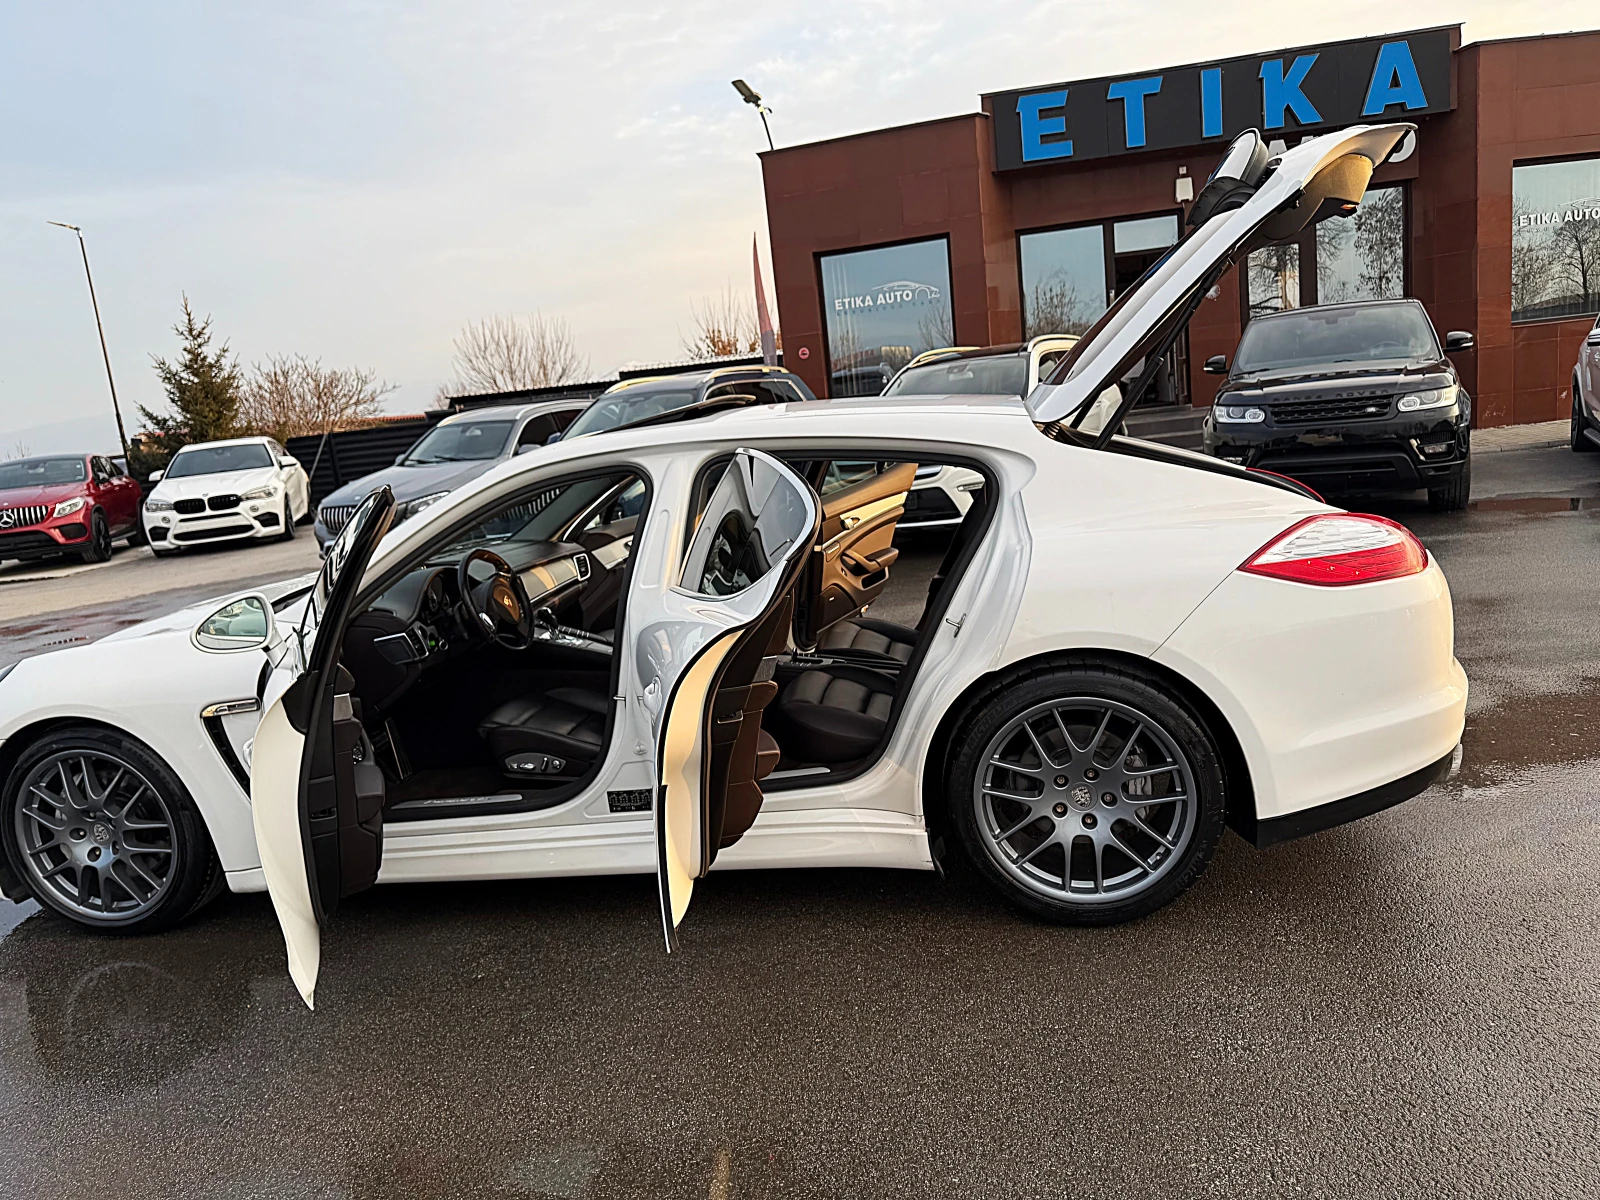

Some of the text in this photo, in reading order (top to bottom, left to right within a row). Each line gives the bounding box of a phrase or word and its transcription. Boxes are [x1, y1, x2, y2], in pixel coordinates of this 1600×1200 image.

[1016, 40, 1428, 162] ETIKA
[1518, 207, 1600, 227] ETIKA AUTO
[834, 290, 912, 310] ETIKA AUTO
[1335, 389, 1389, 398] ROVER
